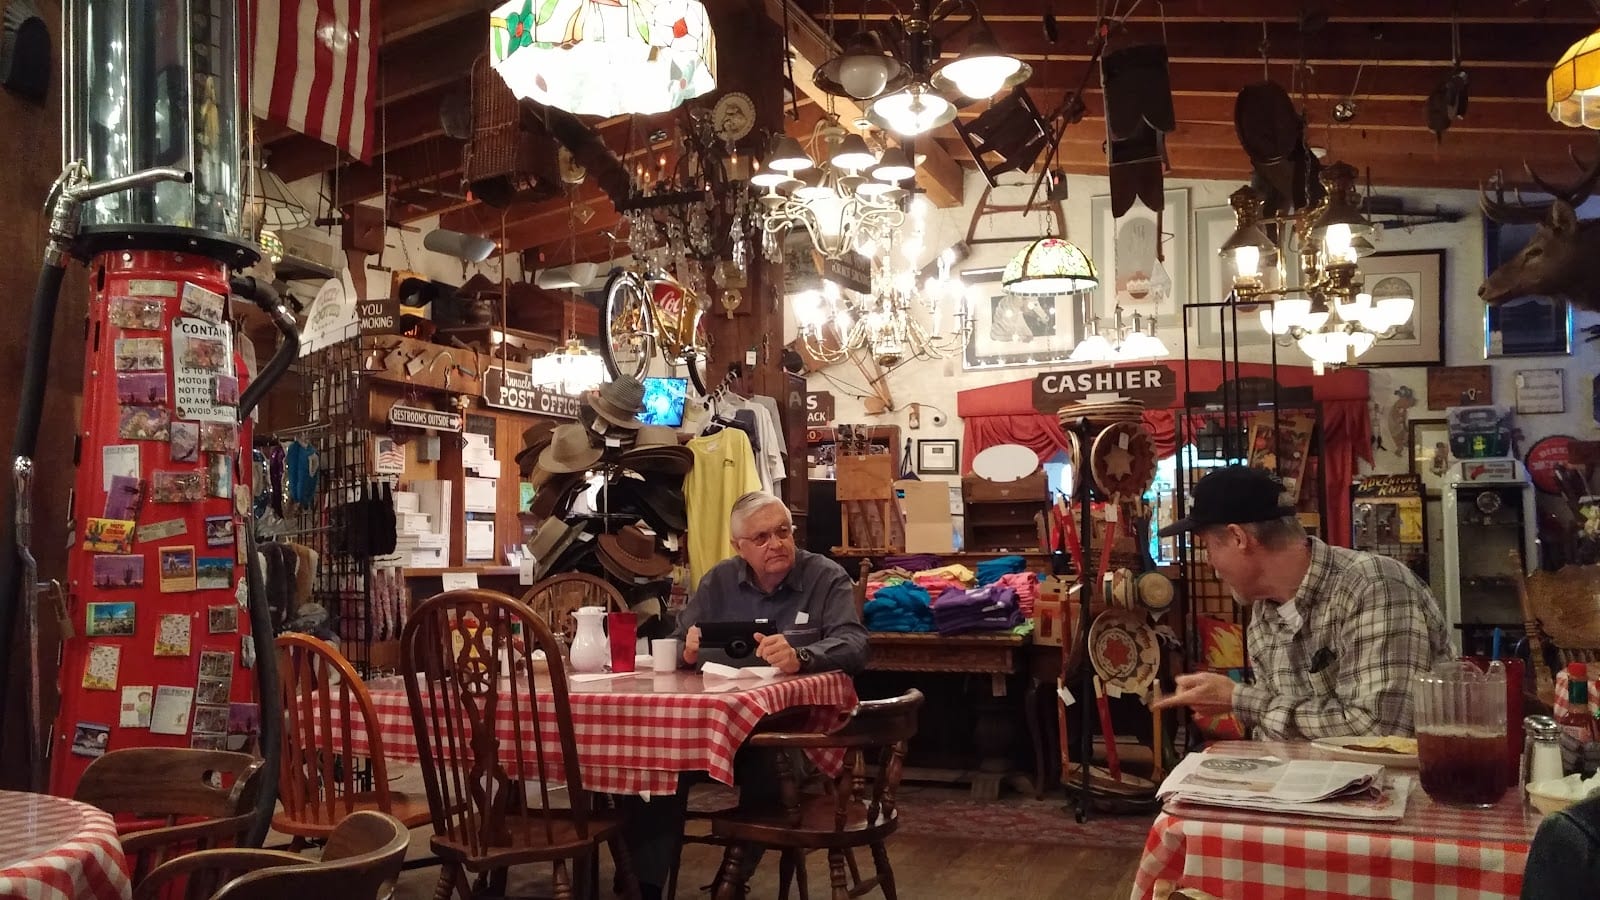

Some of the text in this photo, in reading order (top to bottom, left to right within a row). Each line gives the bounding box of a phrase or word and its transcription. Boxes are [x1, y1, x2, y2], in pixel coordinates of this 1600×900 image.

[361, 304, 383, 316] YOU
[178, 377, 207, 385] MOTOR
[1042, 369, 1162, 394] CASHIER
[499, 386, 535, 409] POST
[187, 407, 211, 415] AVOID
[393, 409, 450, 427] RESTROOMS OUTSIDE
